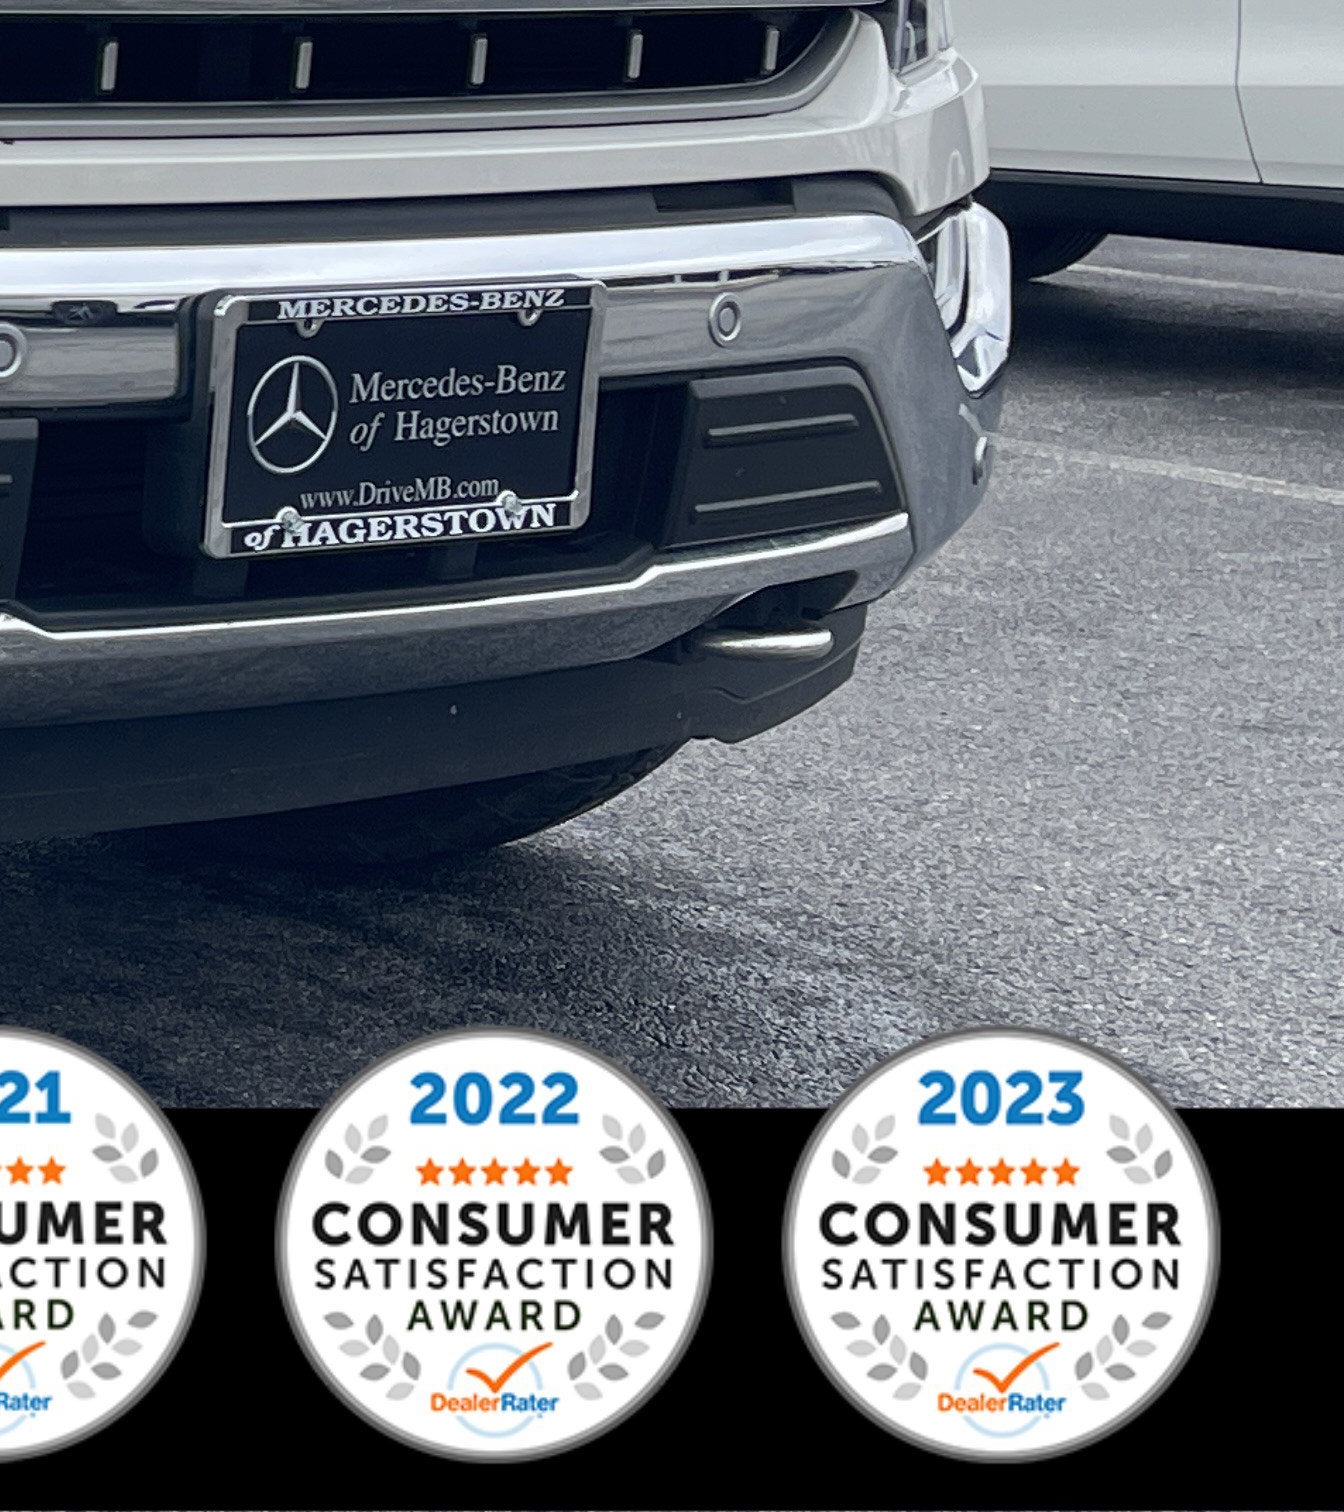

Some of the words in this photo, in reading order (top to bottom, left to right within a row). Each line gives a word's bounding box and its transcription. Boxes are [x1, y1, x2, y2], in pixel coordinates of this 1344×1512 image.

[278, 288, 565, 319] MERCEDES-BENZ
[349, 364, 567, 404] Mercedes-Benz
[350, 412, 385, 451] of
[394, 408, 560, 447] Hagerstown
[300, 476, 500, 509] www.DriveMB.com
[244, 523, 282, 551] of
[281, 502, 557, 548] HAGERSTOWN
